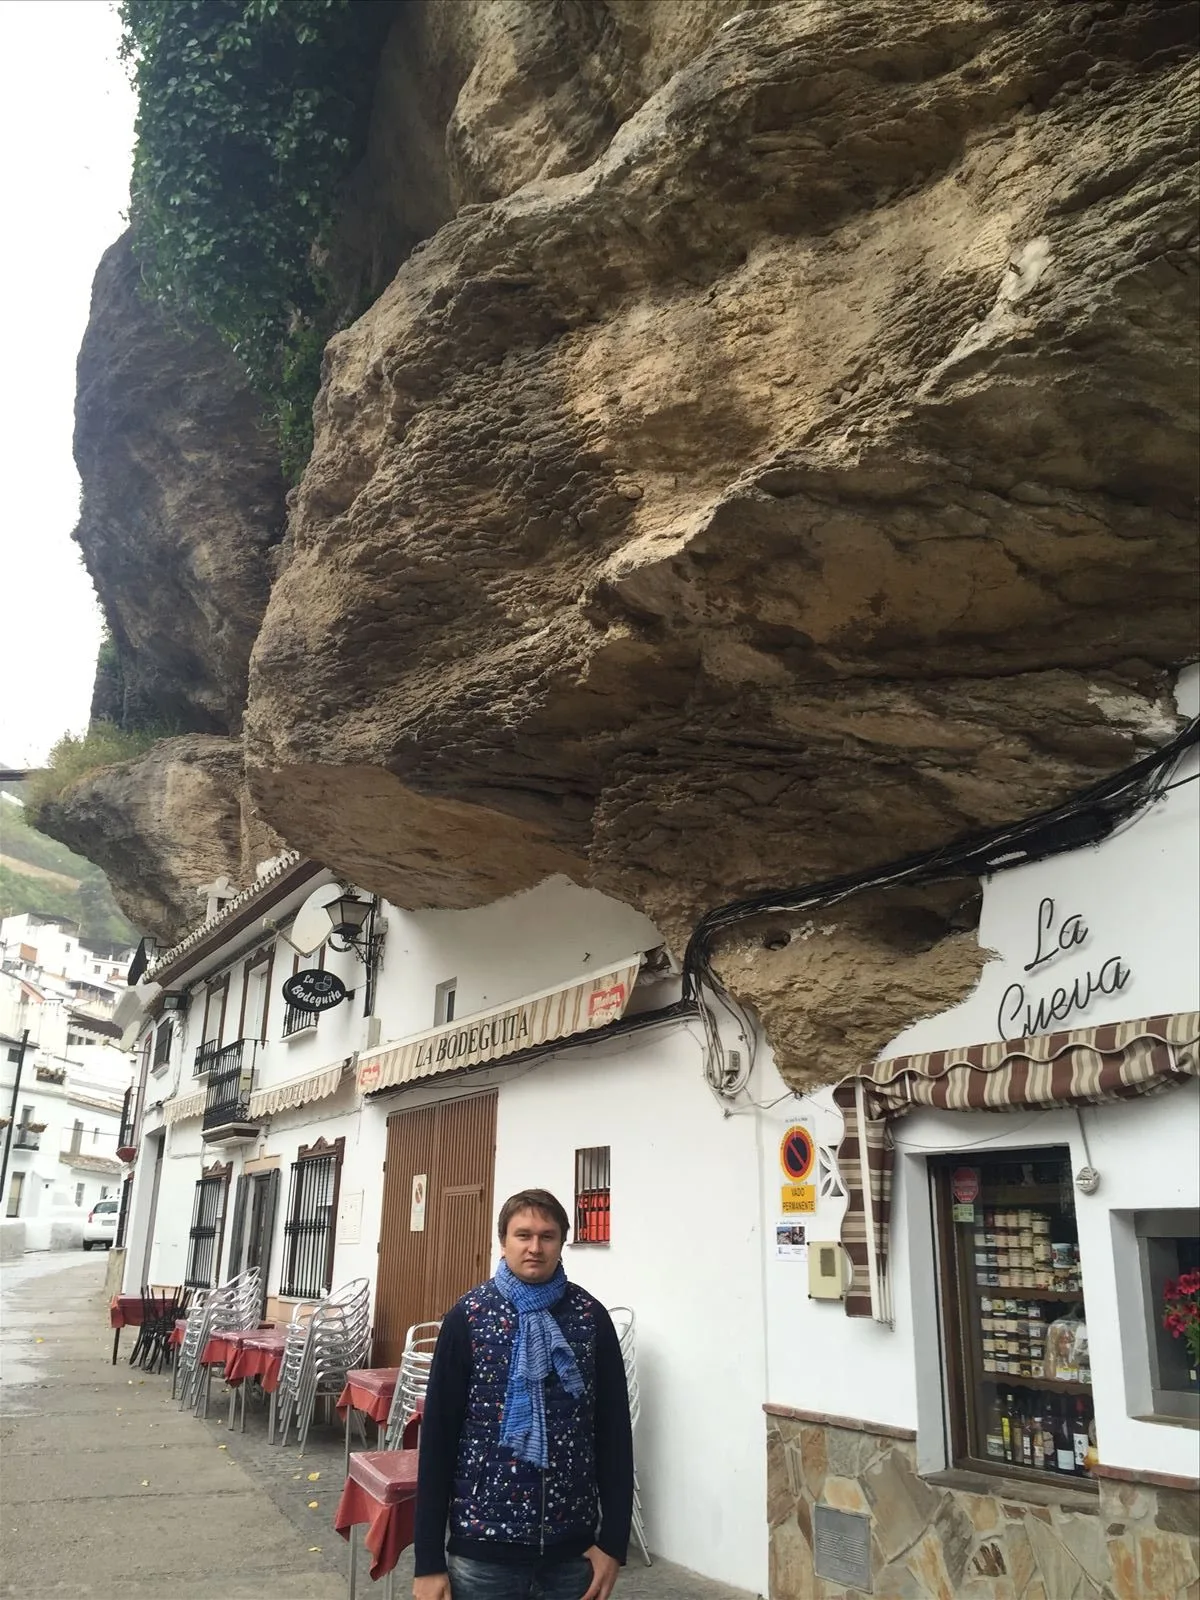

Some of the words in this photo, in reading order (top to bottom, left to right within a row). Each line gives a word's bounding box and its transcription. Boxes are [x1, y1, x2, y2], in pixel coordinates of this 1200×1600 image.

[1023, 897, 1089, 972] La
[302, 974, 315, 984] La
[290, 984, 342, 1007] Bodeguita
[997, 955, 1131, 1041] Cueva
[414, 1044, 433, 1068] LA
[435, 1010, 529, 1062] BODEGUITA
[791, 1187, 805, 1197] VADO
[782, 1200, 815, 1212] PERMANENTE
